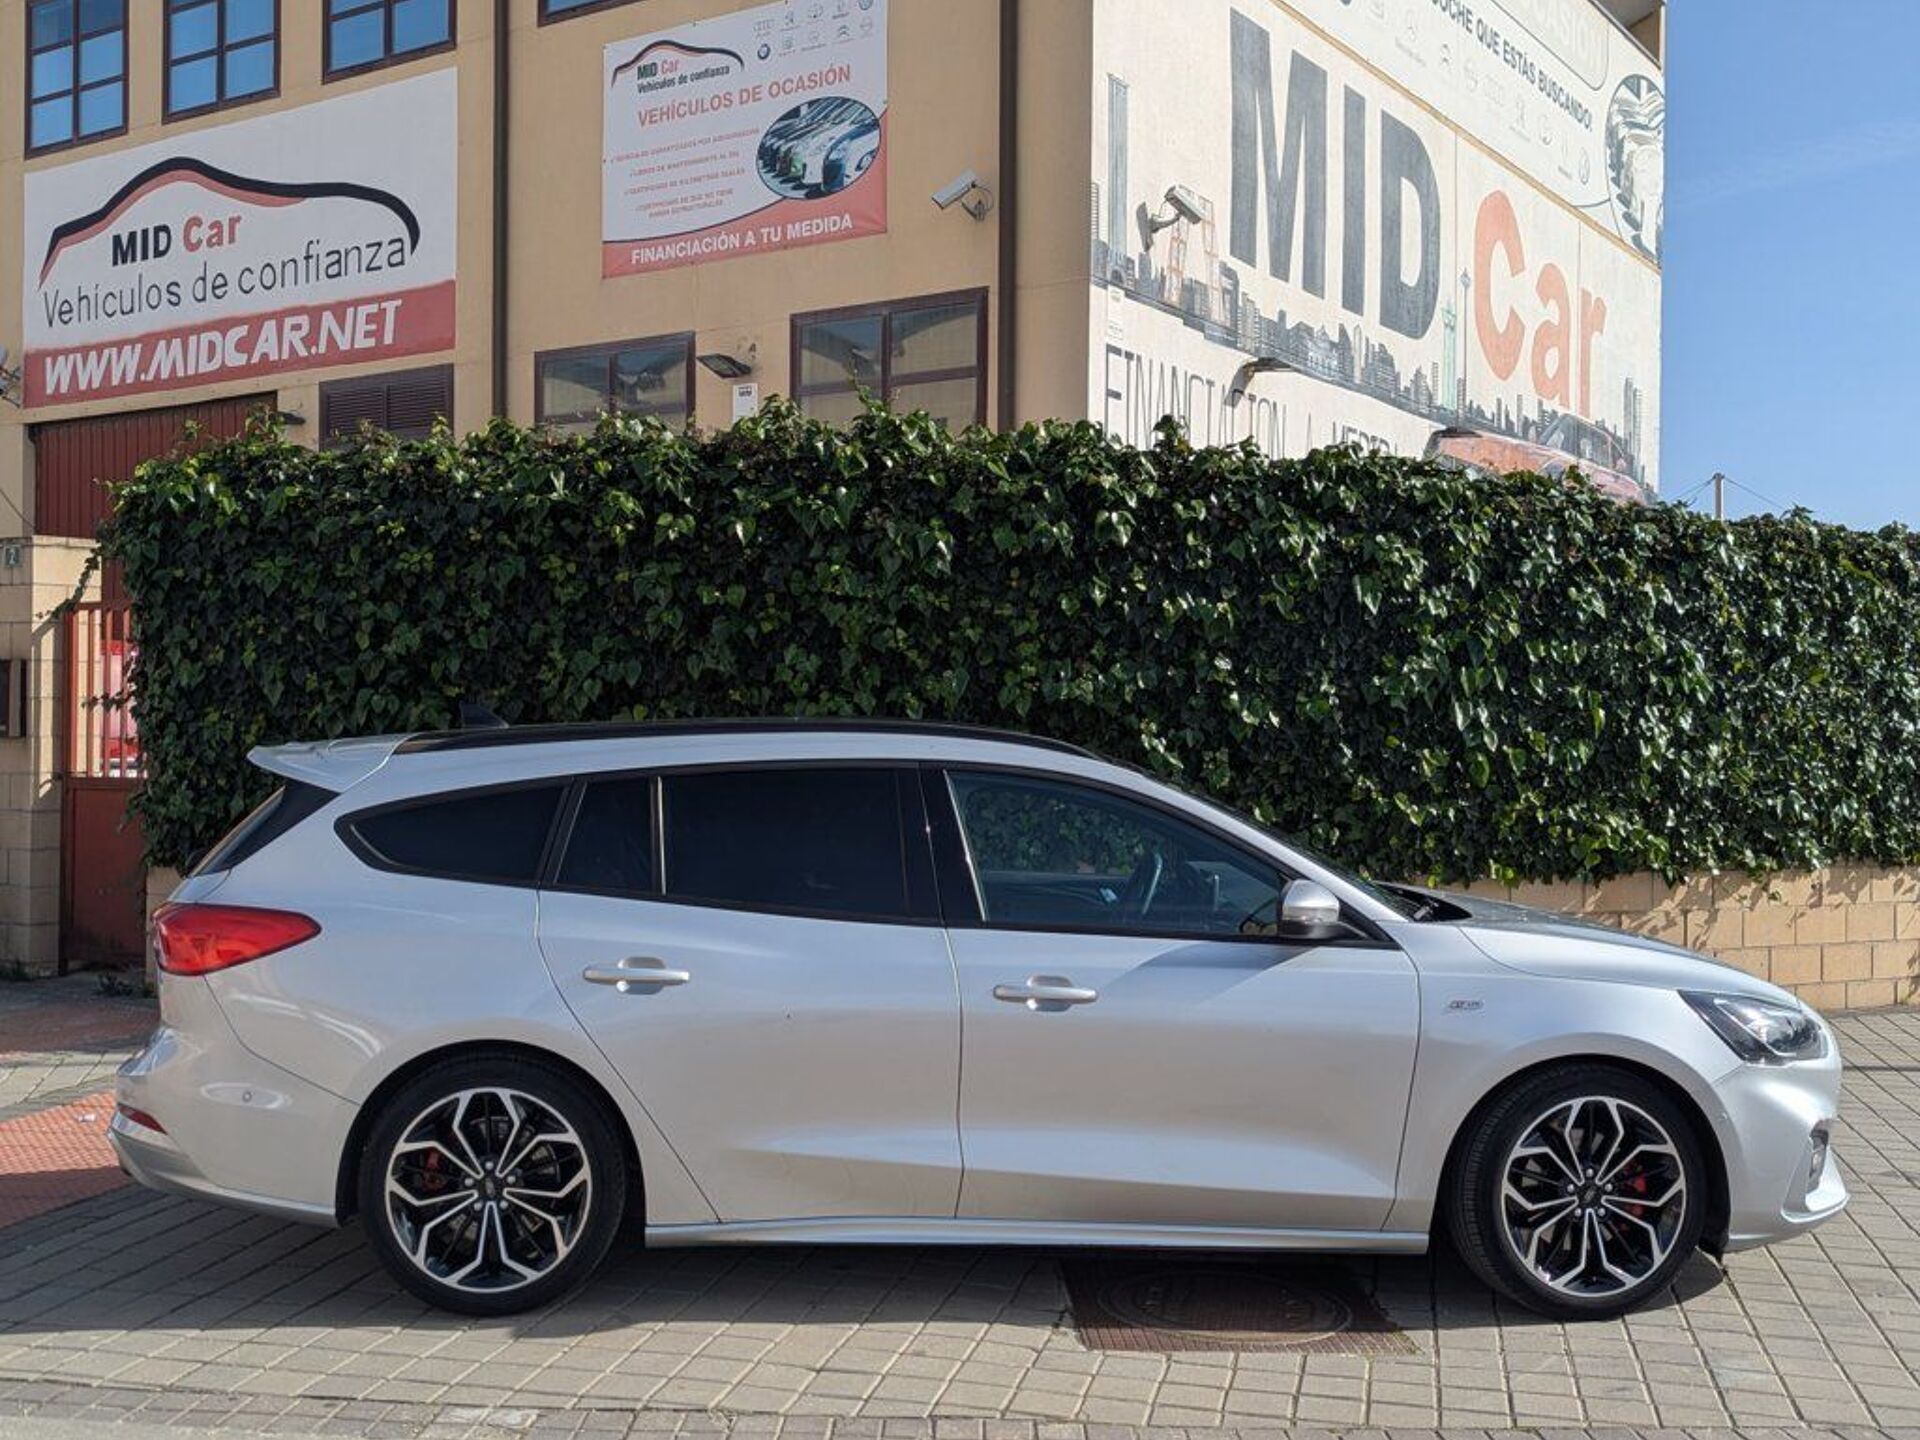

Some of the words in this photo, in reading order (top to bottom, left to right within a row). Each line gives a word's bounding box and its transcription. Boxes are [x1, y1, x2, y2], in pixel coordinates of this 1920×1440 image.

[1476, 17, 1500, 56] QUE
[637, 62, 658, 80] MID
[661, 59, 680, 75] Car
[678, 73, 688, 85] de
[690, 65, 730, 82] confianza
[739, 85, 763, 105] DE
[768, 63, 852, 98] OCASIÓN
[631, 231, 740, 264] FINANCIACIÓN
[744, 230, 756, 246] A
[761, 226, 782, 243] TU
[786, 213, 853, 241] MEDIDA
[1230, 7, 1441, 340] MID
[1474, 190, 1607, 419] Car
[112, 224, 172, 267] MID
[182, 214, 242, 253] Car
[192, 261, 228, 301] de
[238, 237, 407, 296] confianza
[44, 299, 402, 396] WWW.MIDCAR.NET
